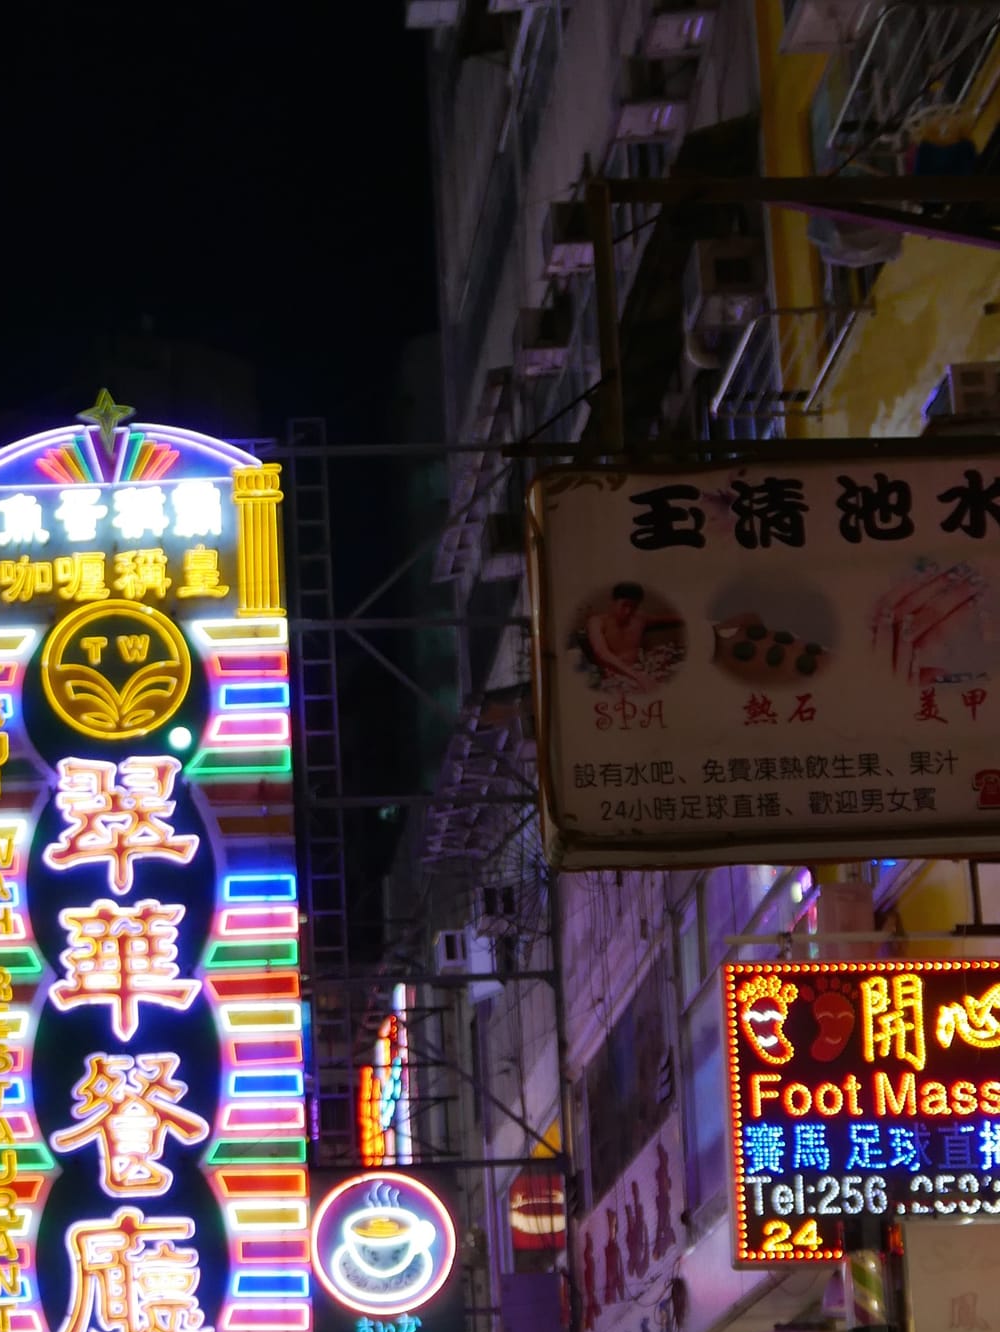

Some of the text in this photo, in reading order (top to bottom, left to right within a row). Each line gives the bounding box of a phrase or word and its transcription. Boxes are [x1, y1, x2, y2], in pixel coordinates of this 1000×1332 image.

[743, 693, 818, 726] 熱石
[913, 688, 988, 724] 美甲
[752, 1073, 863, 1118] Foot
